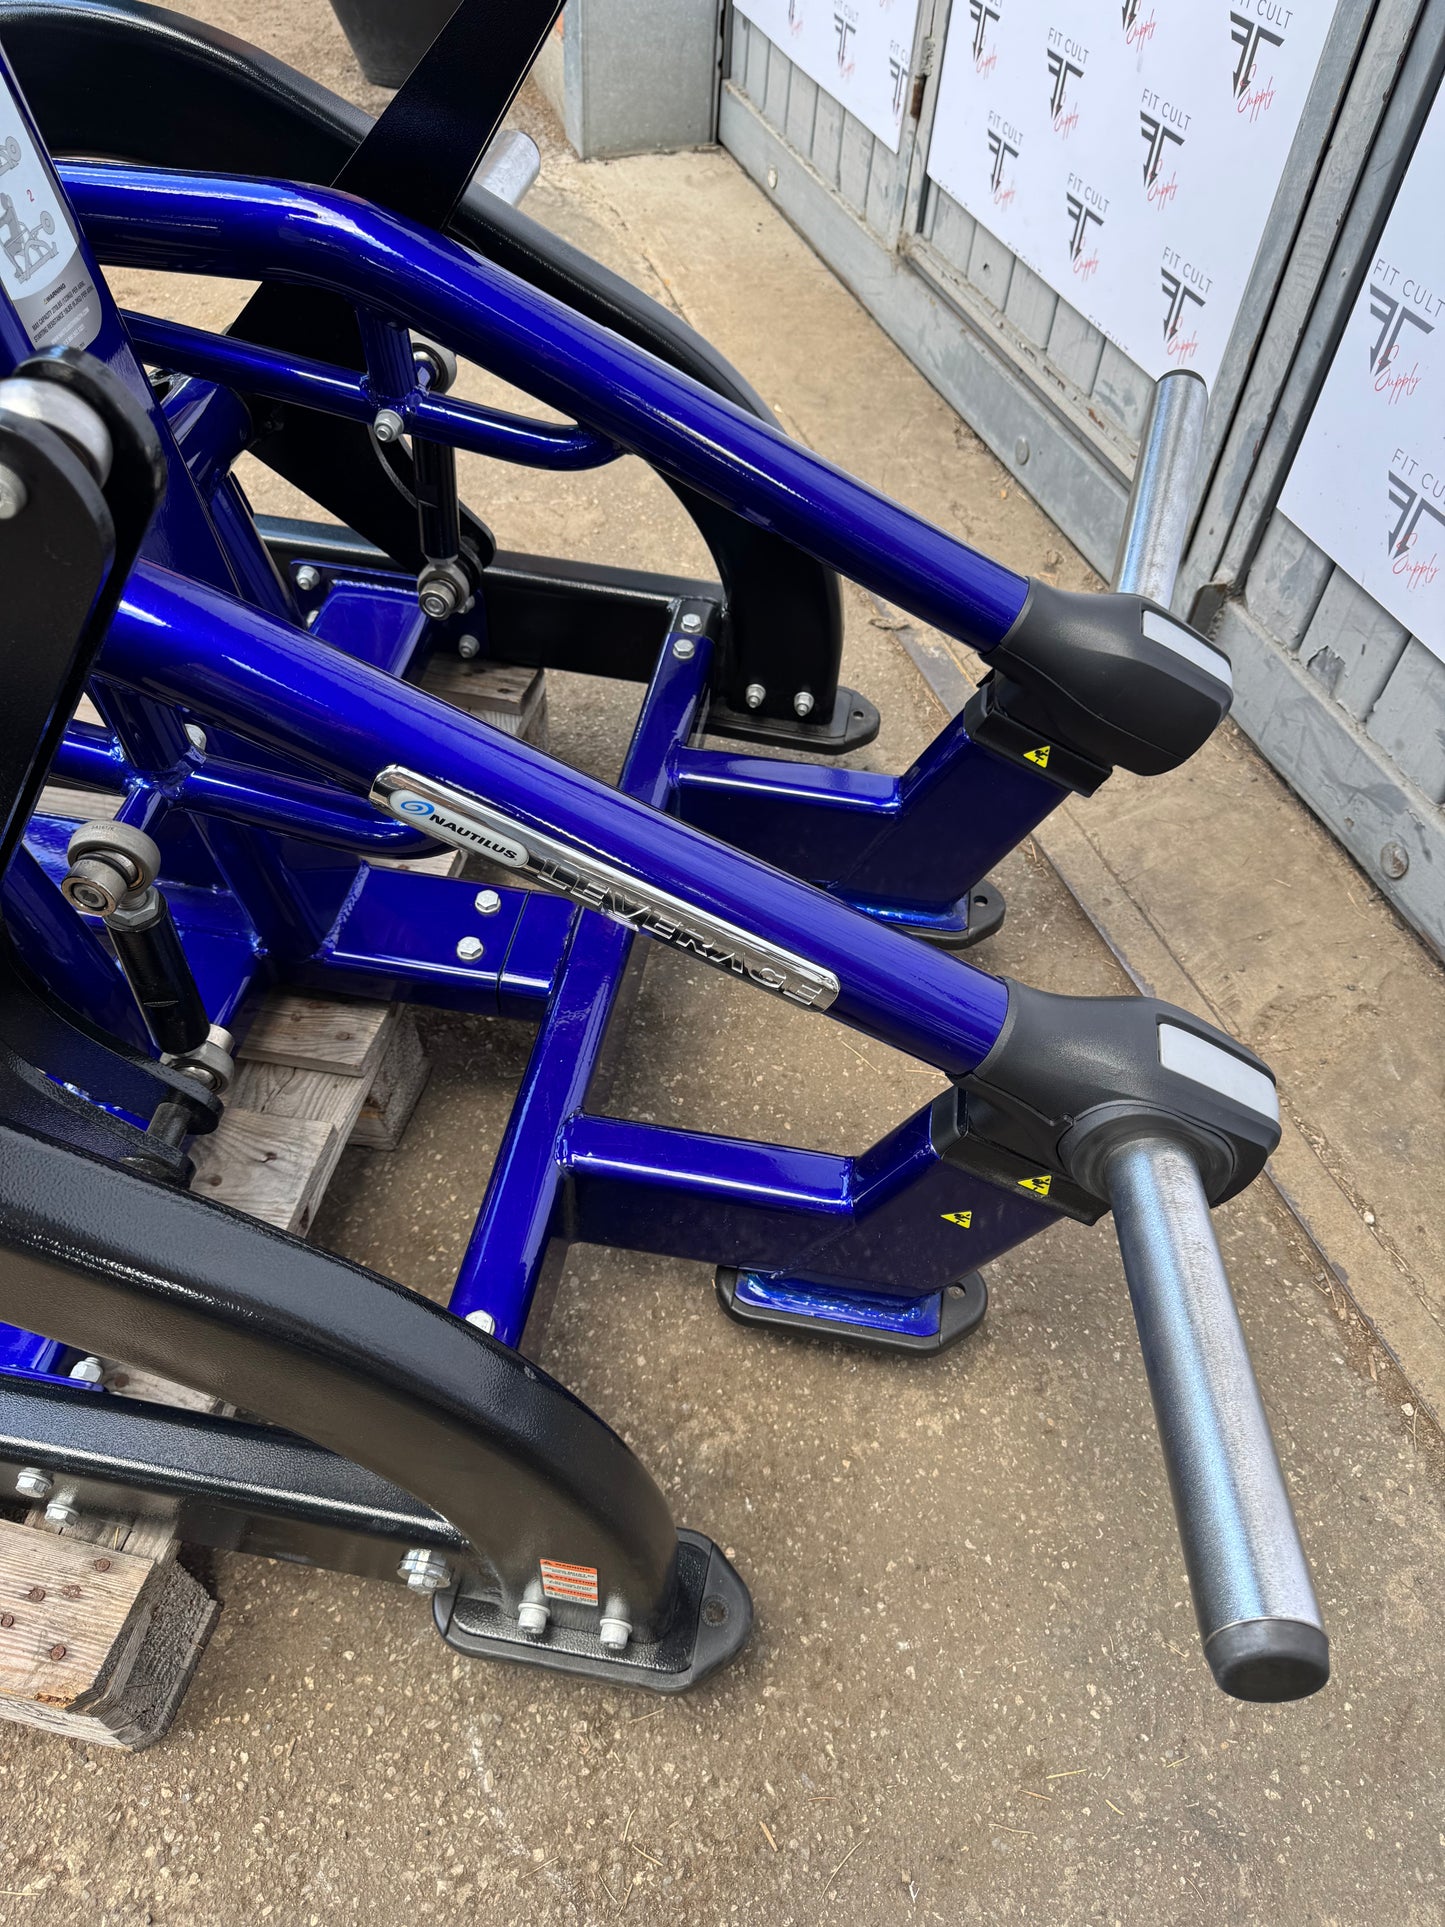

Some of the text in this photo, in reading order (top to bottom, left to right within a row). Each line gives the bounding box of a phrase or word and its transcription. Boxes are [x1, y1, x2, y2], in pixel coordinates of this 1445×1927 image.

[1257, 0, 1293, 29] CULT
[1048, 26, 1090, 64] FIT CULT
[1141, 88, 1192, 131] FIT CULT
[1237, 64, 1276, 123] Supply
[988, 110, 1024, 146] FIT CULT
[26, 189, 35, 202] 2
[1067, 172, 1110, 214] FIT CULT
[1147, 159, 1178, 211] Supply
[46, 283, 66, 303] WARNING
[1162, 246, 1214, 294] FIT CULT
[1373, 258, 1445, 318] FIT CULT
[1374, 344, 1422, 405] Supply
[1392, 448, 1445, 499] FIT CU
[1392, 532, 1440, 590] Supply
[429, 814, 518, 860] NAUTILUS
[536, 859, 825, 1006] LEVERAGE
